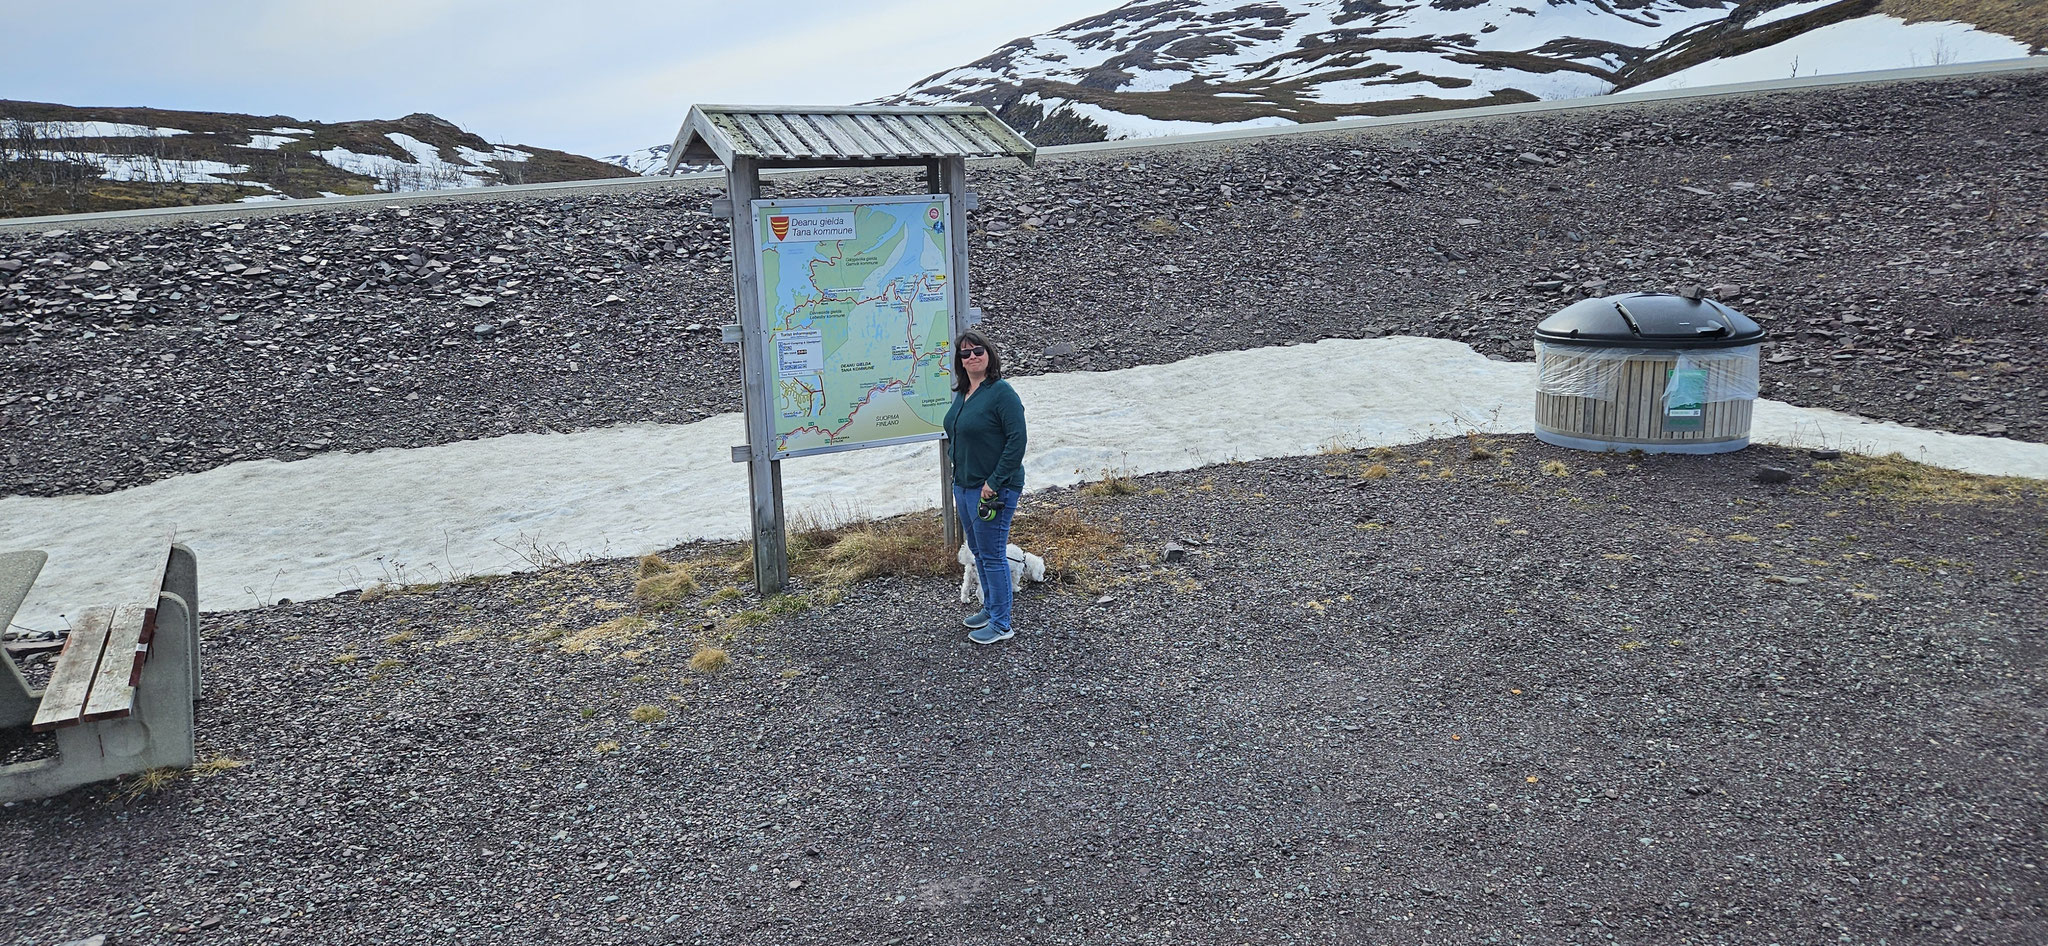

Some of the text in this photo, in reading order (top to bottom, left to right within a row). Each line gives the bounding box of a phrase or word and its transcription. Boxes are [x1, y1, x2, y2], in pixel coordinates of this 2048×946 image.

[791, 217, 844, 227] Deanu gielda
[813, 227, 853, 236] kommune
